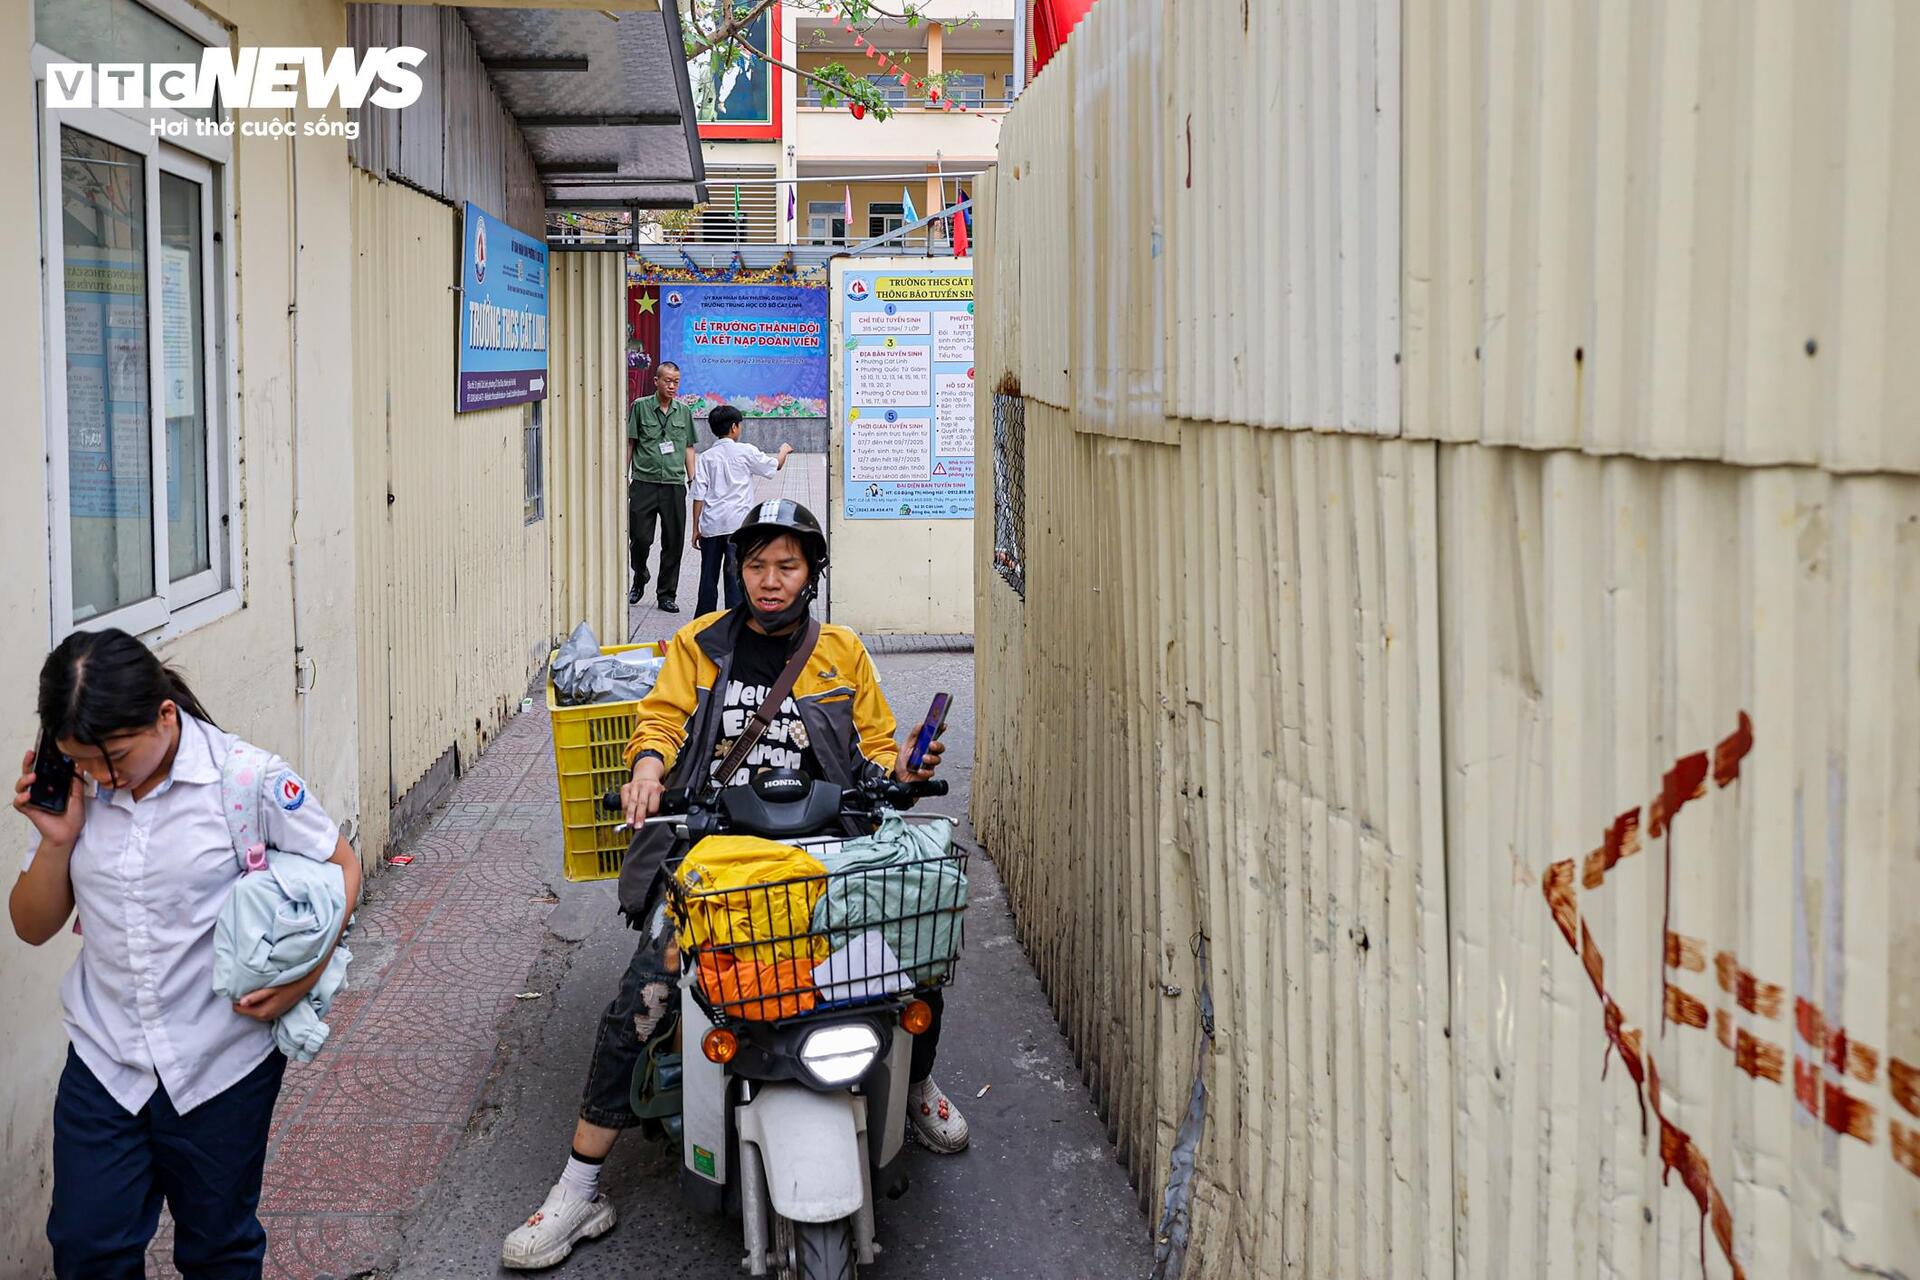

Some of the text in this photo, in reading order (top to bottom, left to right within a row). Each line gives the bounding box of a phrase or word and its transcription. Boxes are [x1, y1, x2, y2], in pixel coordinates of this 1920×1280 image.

[890, 278, 927, 286] TRƯỜNG
[928, 278, 951, 286] THCS
[952, 278, 970, 286] CÁT
[876, 290, 908, 298] THÔNG
[909, 290, 928, 298] BÁO
[928, 290, 960, 298] TUYỂN
[960, 290, 974, 298] SIN
[502, 307, 519, 351] THCS
[520, 304, 533, 351] CÁT
[694, 318, 706, 331] LỄ
[758, 321, 796, 333] THÀNH
[799, 322, 819, 334] ĐỘI
[694, 333, 819, 348] VÀ KẾT NẠP ĐOÀN VIÊN
[888, 338, 894, 348] 3
[888, 412, 894, 420] 5
[764, 779, 802, 788] HONDA
